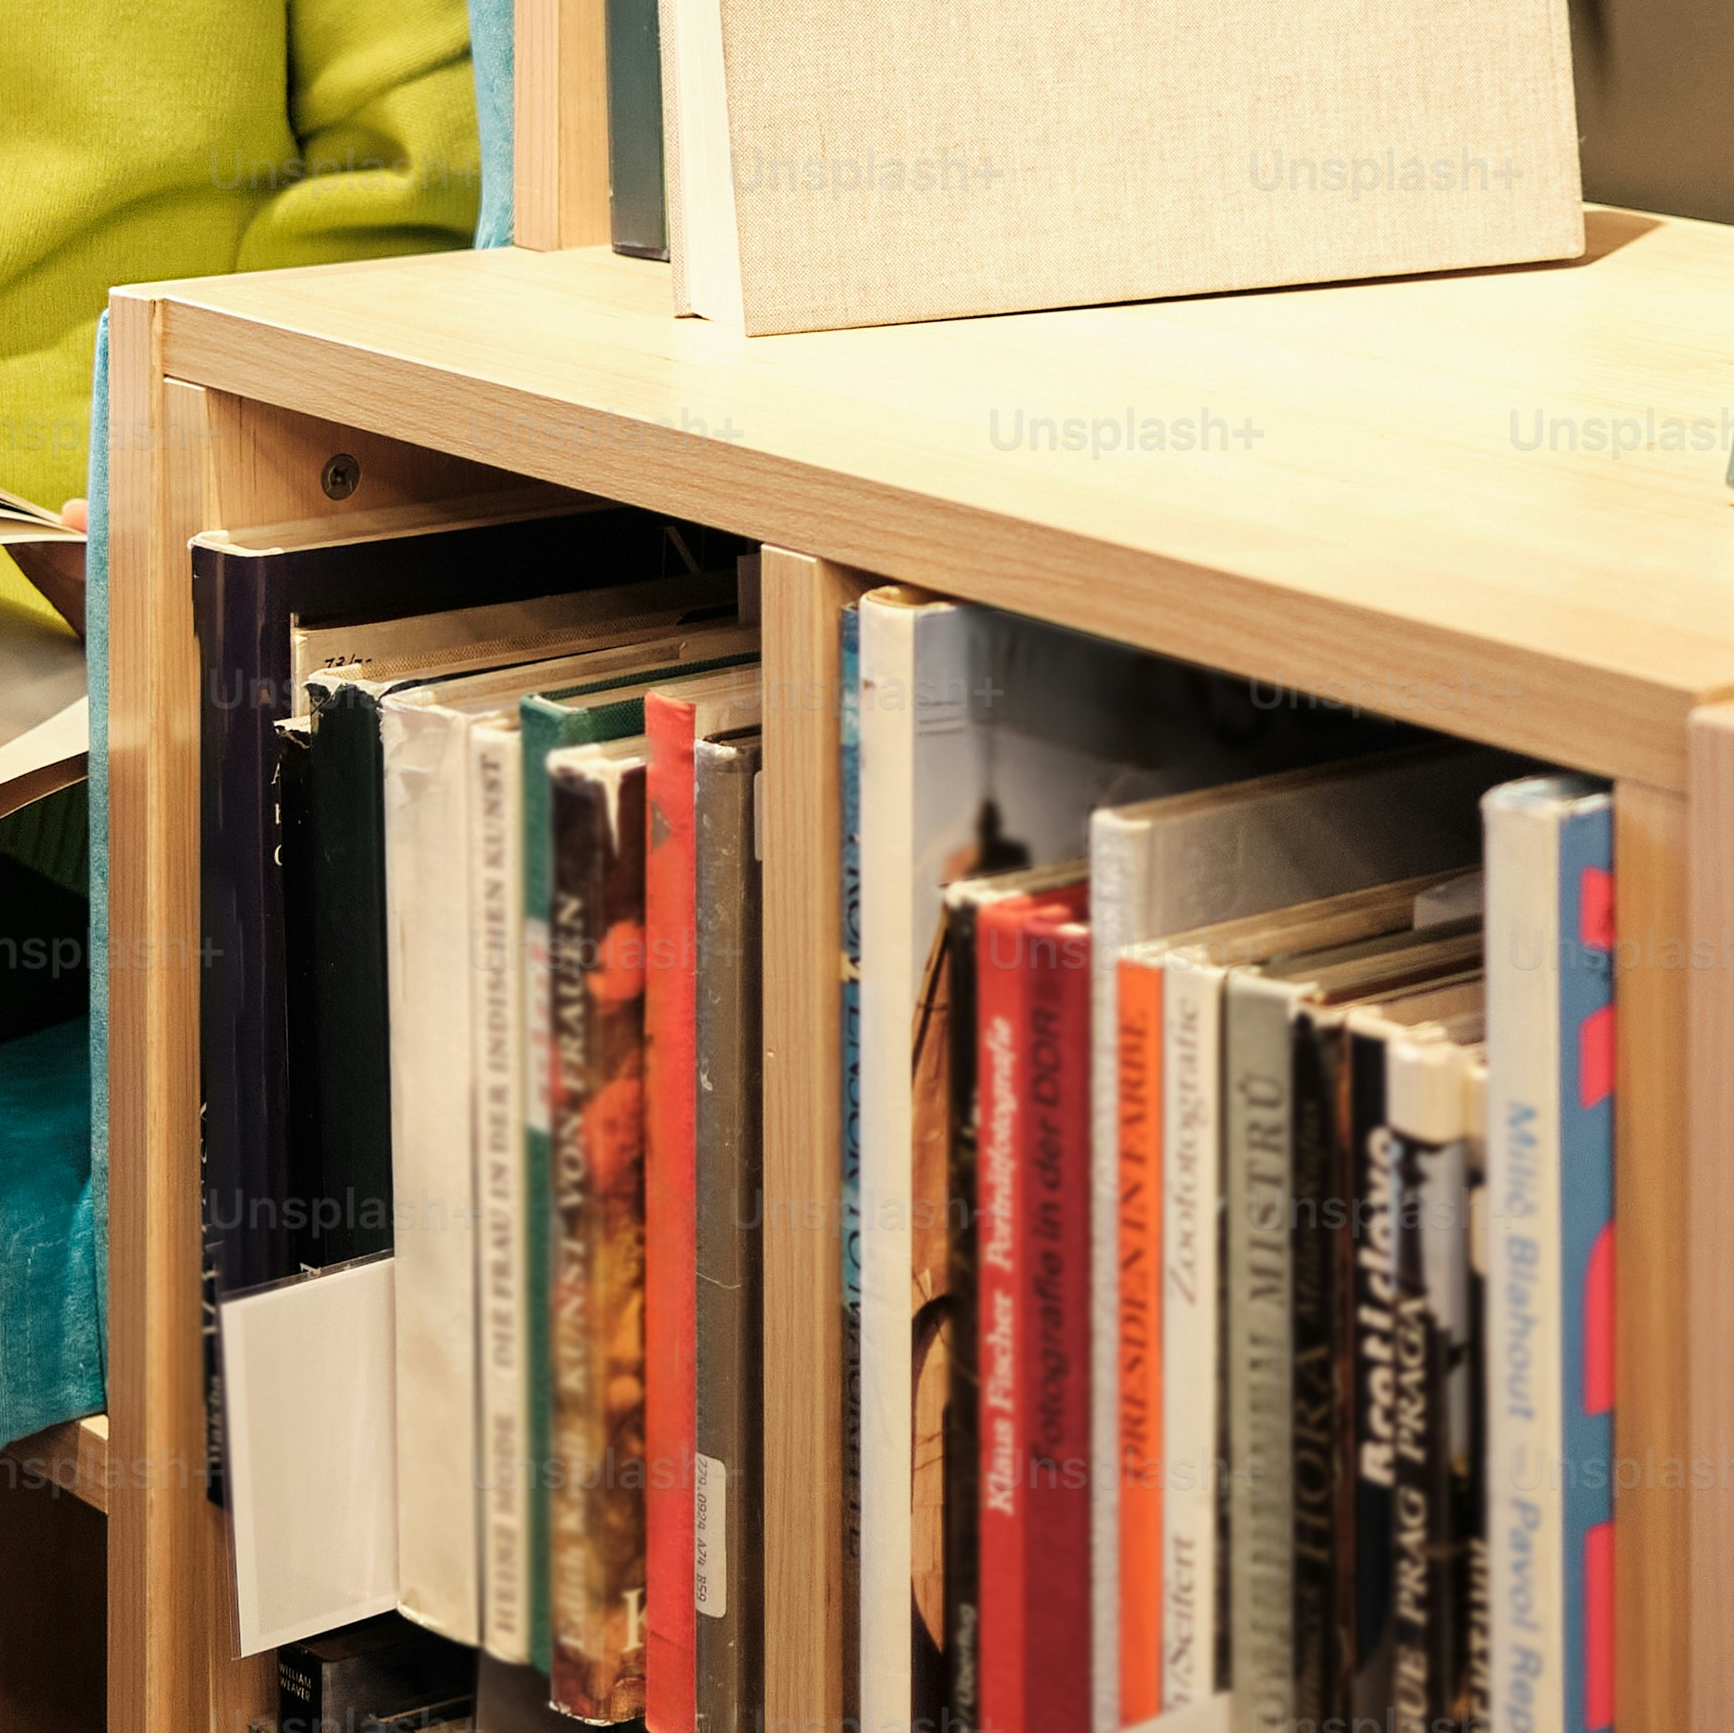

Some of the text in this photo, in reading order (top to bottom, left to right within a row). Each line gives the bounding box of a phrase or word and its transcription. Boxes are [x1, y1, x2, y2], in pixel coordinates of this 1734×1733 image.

[480, 753, 504, 869] KUNST
[483, 877, 510, 1072] INDISCHEN
[556, 892, 586, 1095] FRAUEN
[486, 1087, 510, 1155] DER
[557, 1112, 585, 1208] VON
[1165, 994, 1207, 1306] Zoofotografie
[489, 1209, 514, 1300] FRAU
[1030, 1006, 1069, 1473] Fotografie in der DDR
[1119, 1005, 1150, 1483] DRESDEN IN FARBE
[558, 1236, 586, 1394] KUNST
[985, 1290, 1016, 1412] Fischer
[1393, 1293, 1428, 1464] PRAGA
[1504, 1234, 1538, 1421] Blahout
[987, 1418, 1016, 1515] Klaus
[1294, 1343, 1331, 1565] HORA
[1393, 1484, 1431, 1628] PRAG
[1508, 1496, 1543, 1635] Pavol
[278, 1663, 313, 1689] WILLIAM
[279, 1677, 312, 1703] WEAVER
